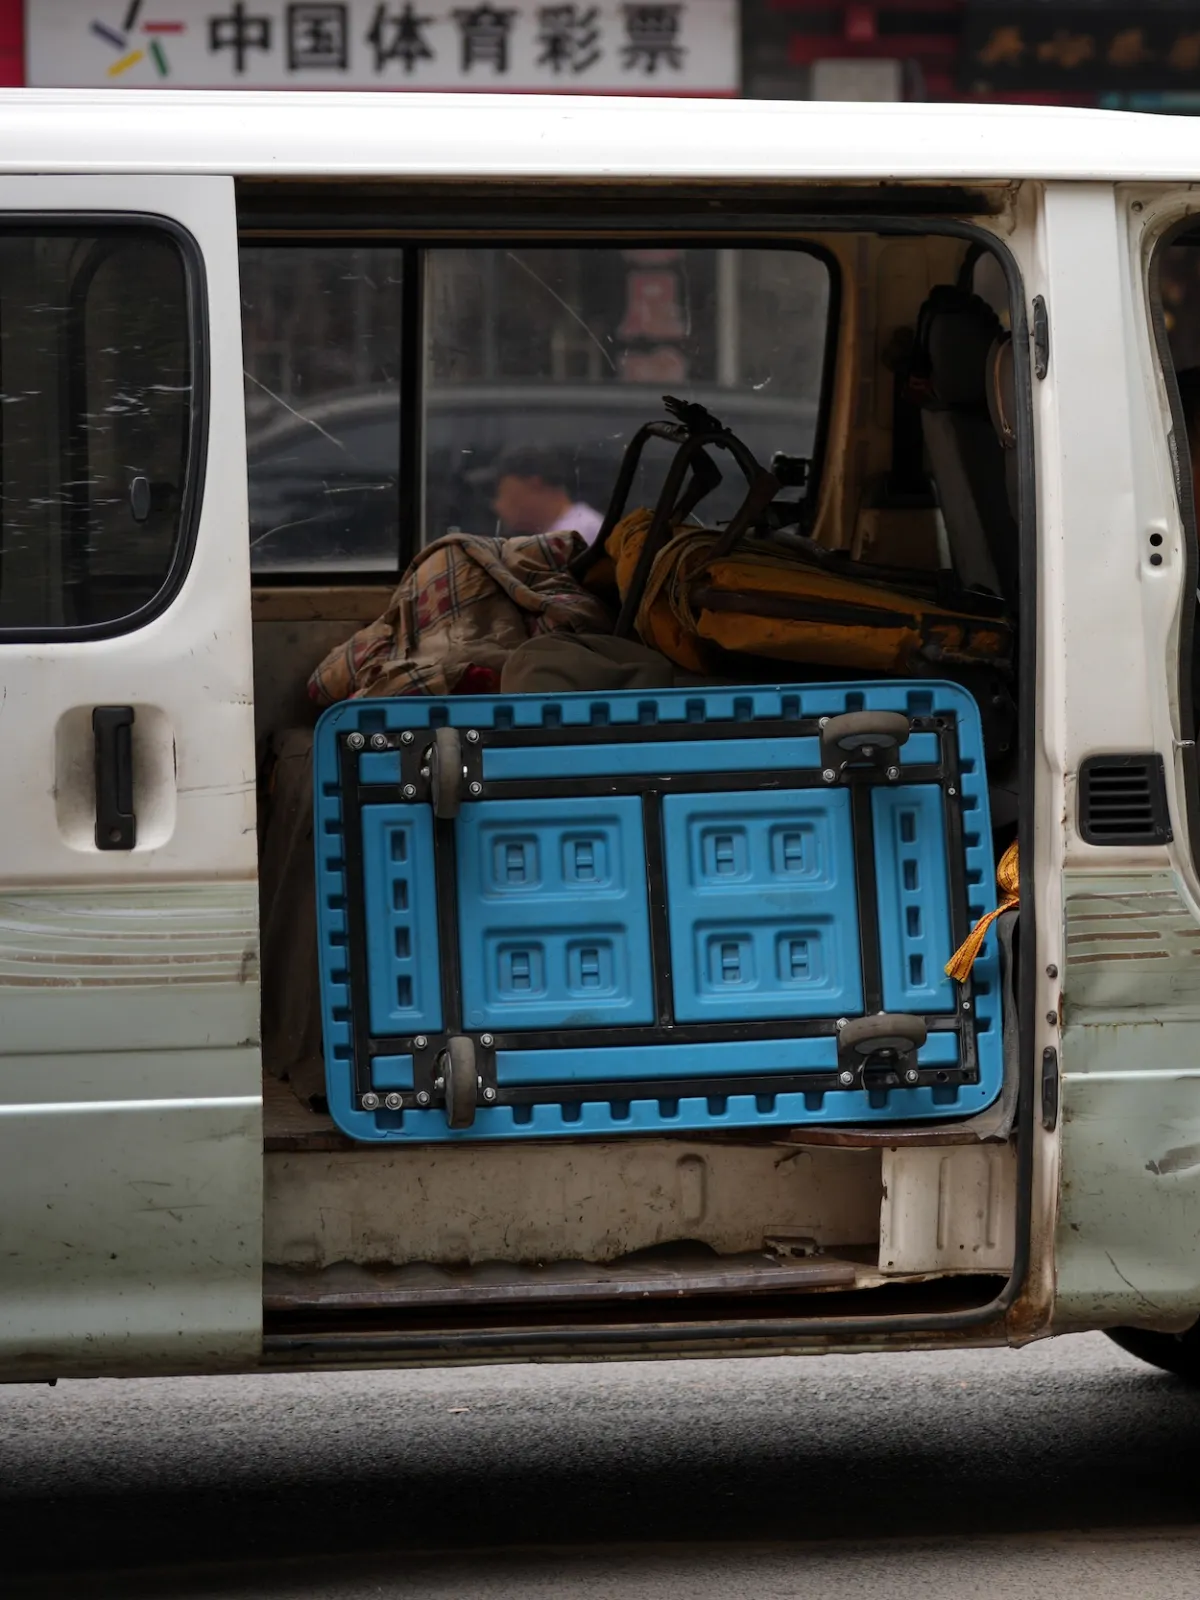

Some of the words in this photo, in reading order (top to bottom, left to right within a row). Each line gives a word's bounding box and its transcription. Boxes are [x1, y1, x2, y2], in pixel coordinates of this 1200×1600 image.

[207, 1, 689, 75] 中国体育彩票
